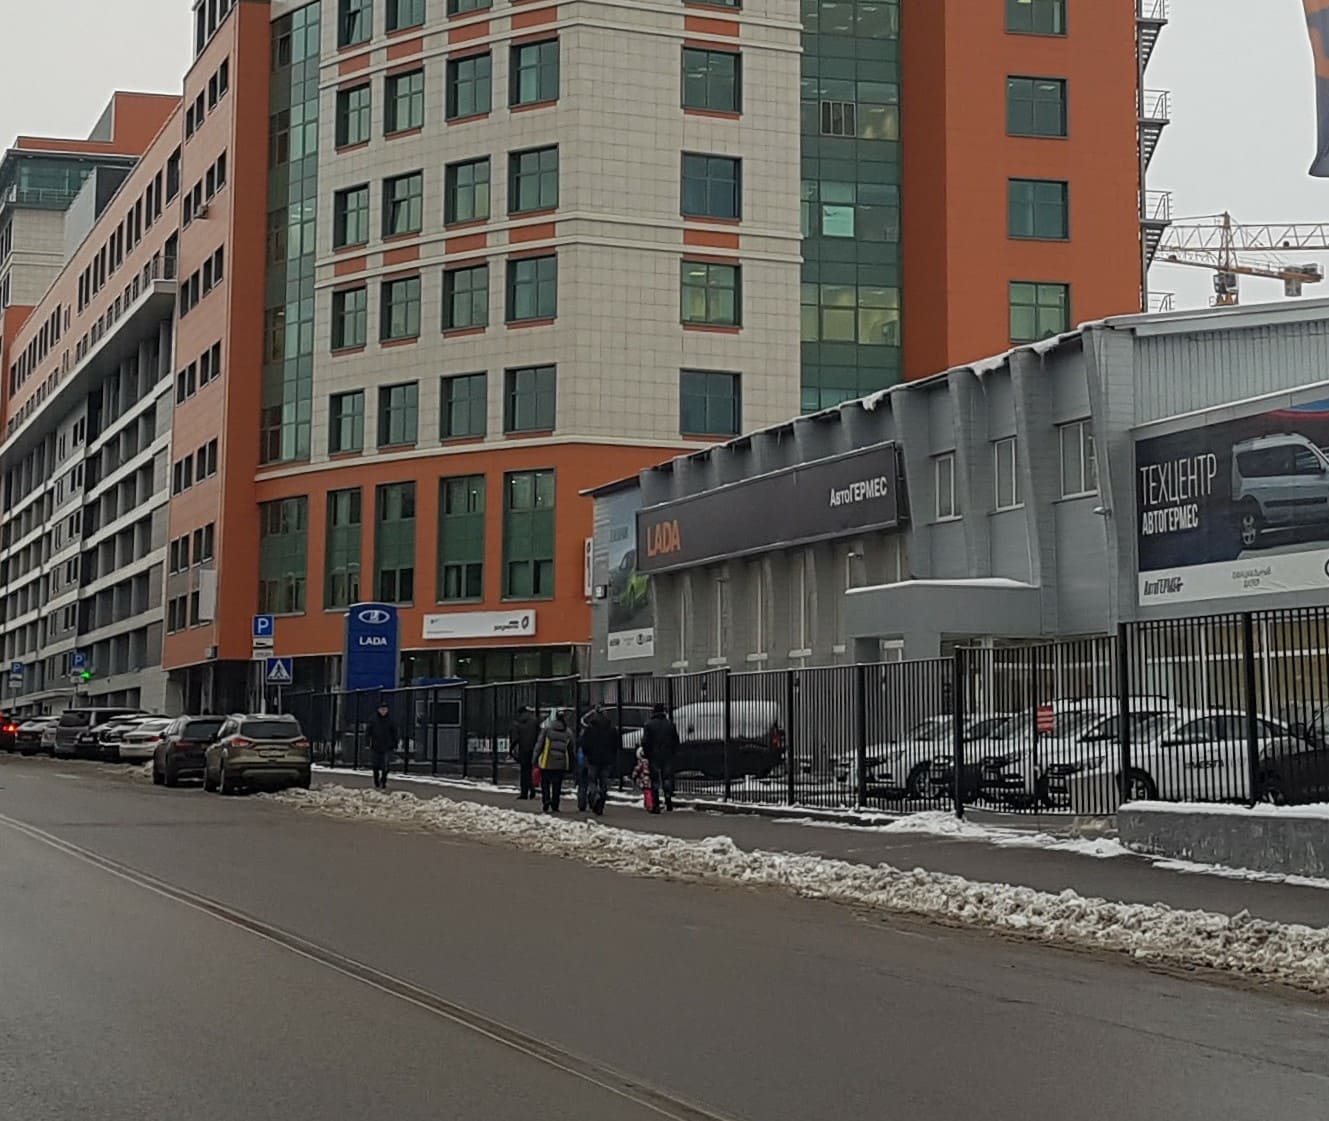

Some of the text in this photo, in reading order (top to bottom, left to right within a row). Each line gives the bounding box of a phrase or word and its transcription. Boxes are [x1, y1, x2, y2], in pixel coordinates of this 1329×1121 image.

[1140, 453, 1217, 506] ТЕХЦЕНТР
[1142, 504, 1199, 535] АВТОГЕРМЕС
[647, 520, 681, 557] LADA
[359, 637, 388, 646] LADA
